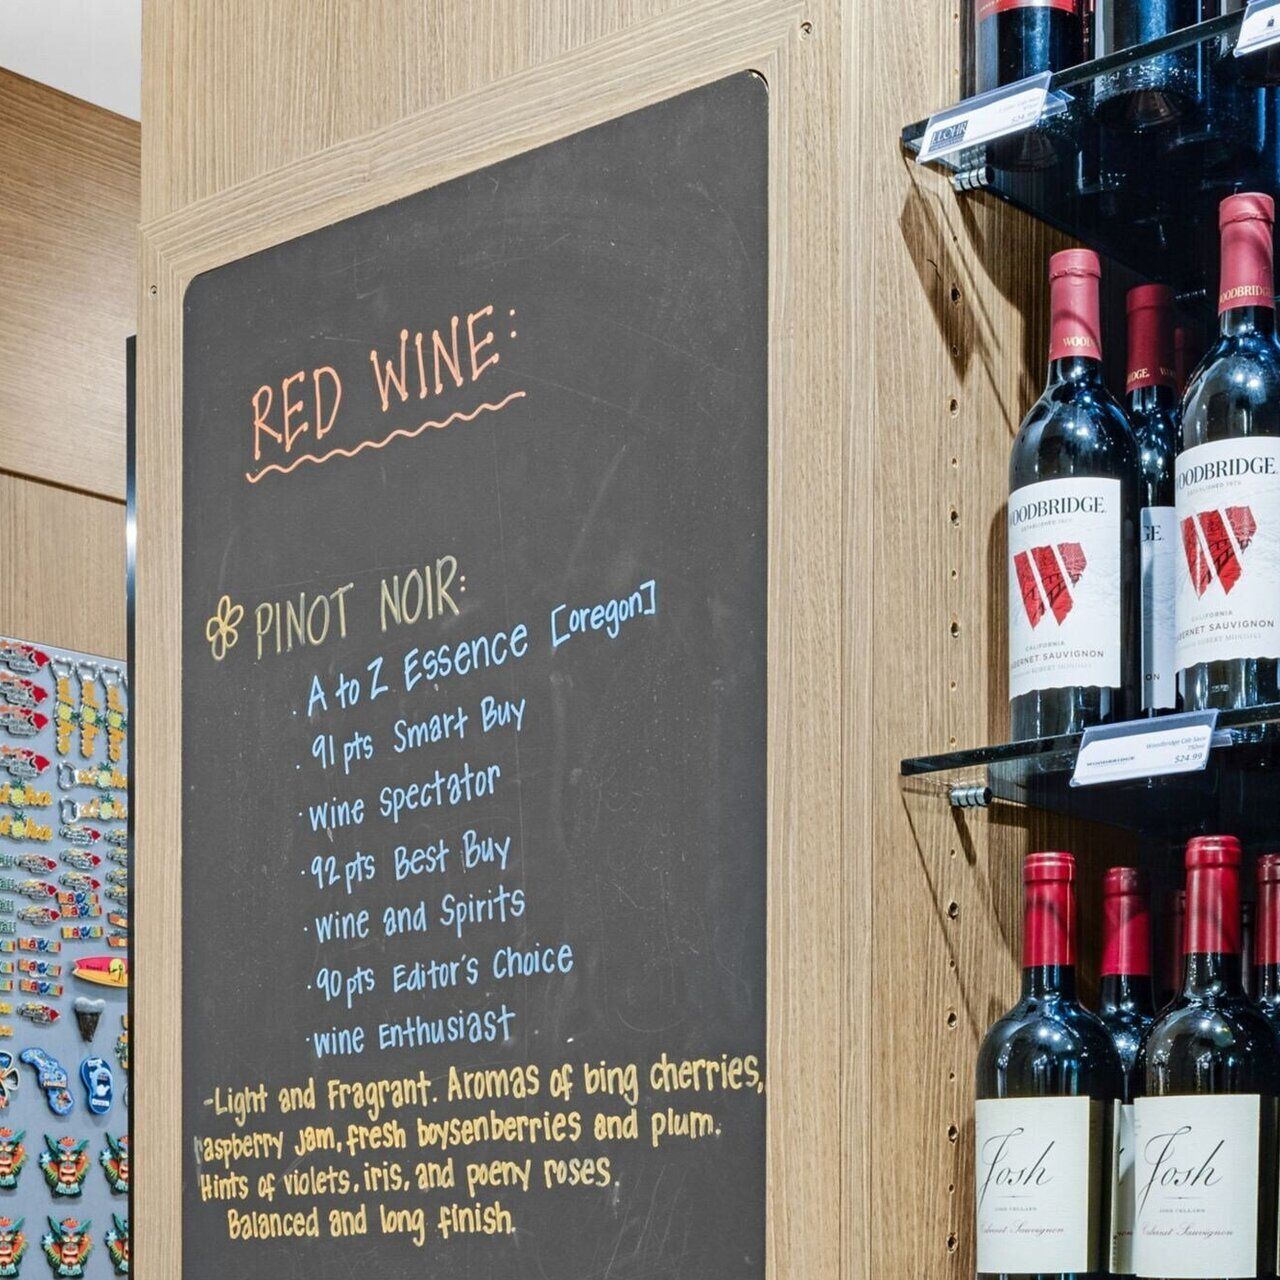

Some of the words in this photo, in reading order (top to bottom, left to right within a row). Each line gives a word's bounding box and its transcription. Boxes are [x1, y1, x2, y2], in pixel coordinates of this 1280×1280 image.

[251, 367, 342, 460] RED
[370, 305, 518, 411] WINE:
[255, 583, 354, 660] PINOT
[380, 555, 467, 632] NOIR:
[307, 675, 328, 717] A
[335, 673, 360, 708] to
[368, 656, 388, 699] Z
[403, 624, 529, 691] Essence
[393, 706, 469, 753] Smart
[481, 695, 526, 731] Buy
[394, 839, 450, 881] Best
[463, 830, 511, 871] Buy
[382, 901, 427, 936] and
[440, 884, 526, 938] Spirits
[393, 954, 479, 993] Editor's
[492, 942, 574, 979] Choice
[378, 1003, 516, 1050] Enthusiast
[278, 1076, 316, 1113] and
[327, 1070, 438, 1122] Fragrant.
[447, 1065, 540, 1102] Aromas
[550, 1063, 573, 1102] of
[584, 1060, 639, 1106] bing
[650, 1052, 764, 1094] cherries,
[194, 1131, 284, 1169] raspberry
[346, 1119, 406, 1156] fresh
[417, 1109, 582, 1151] boysenberries
[594, 1108, 639, 1140] and
[200, 1171, 248, 1202] Hints
[258, 1172, 276, 1202] of
[283, 1165, 360, 1196] violets,
[363, 1160, 410, 1192] iris,
[415, 1158, 455, 1190] and
[466, 1159, 532, 1198] poeny
[1137, 1125, 1226, 1217] Josh
[228, 1206, 319, 1240] Balanced
[328, 1204, 368, 1238] and
[380, 1204, 425, 1247] long
[437, 1201, 516, 1239] finish.
